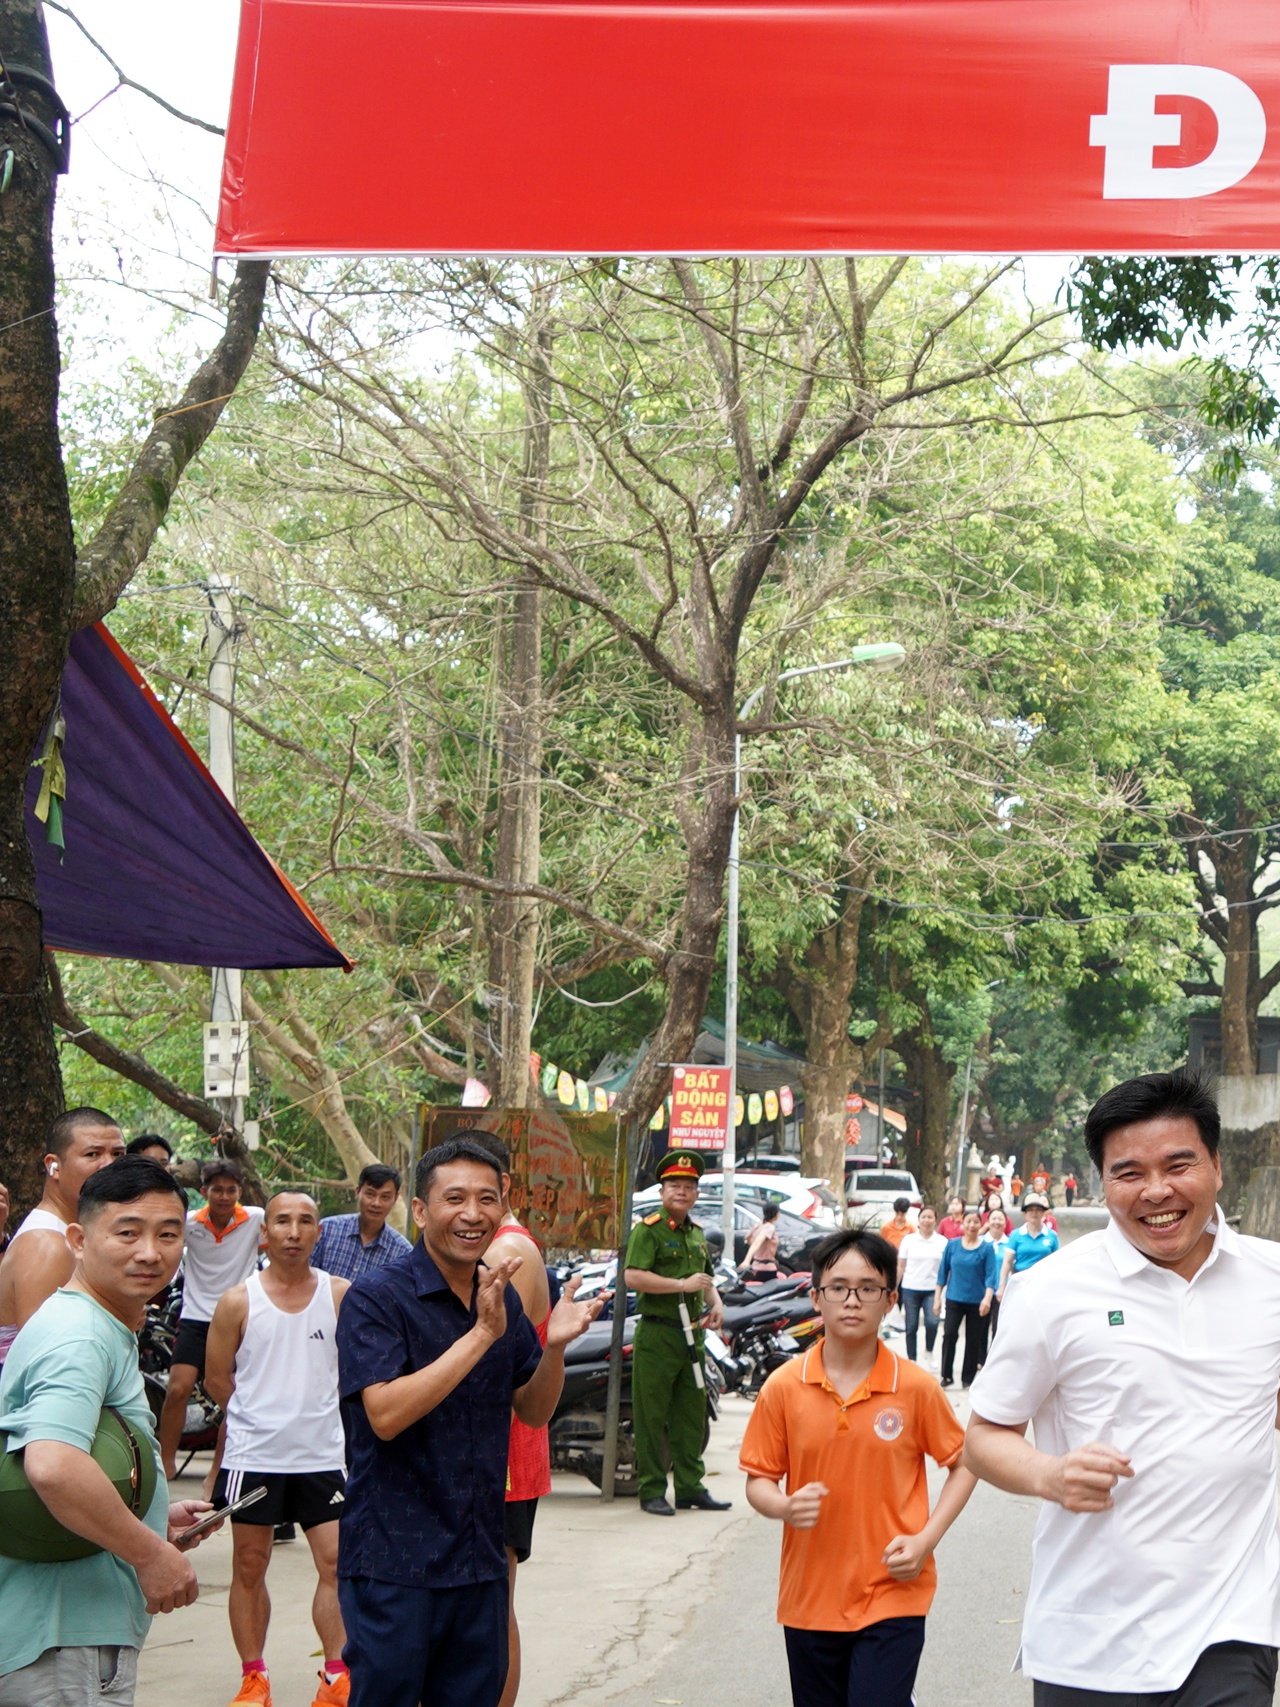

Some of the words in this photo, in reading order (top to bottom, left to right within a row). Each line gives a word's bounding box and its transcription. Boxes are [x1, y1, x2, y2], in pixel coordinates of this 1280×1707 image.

[684, 1069, 720, 1089] BẤT
[675, 1088, 727, 1109] ĐỘNG
[680, 1106, 720, 1127] SẢN
